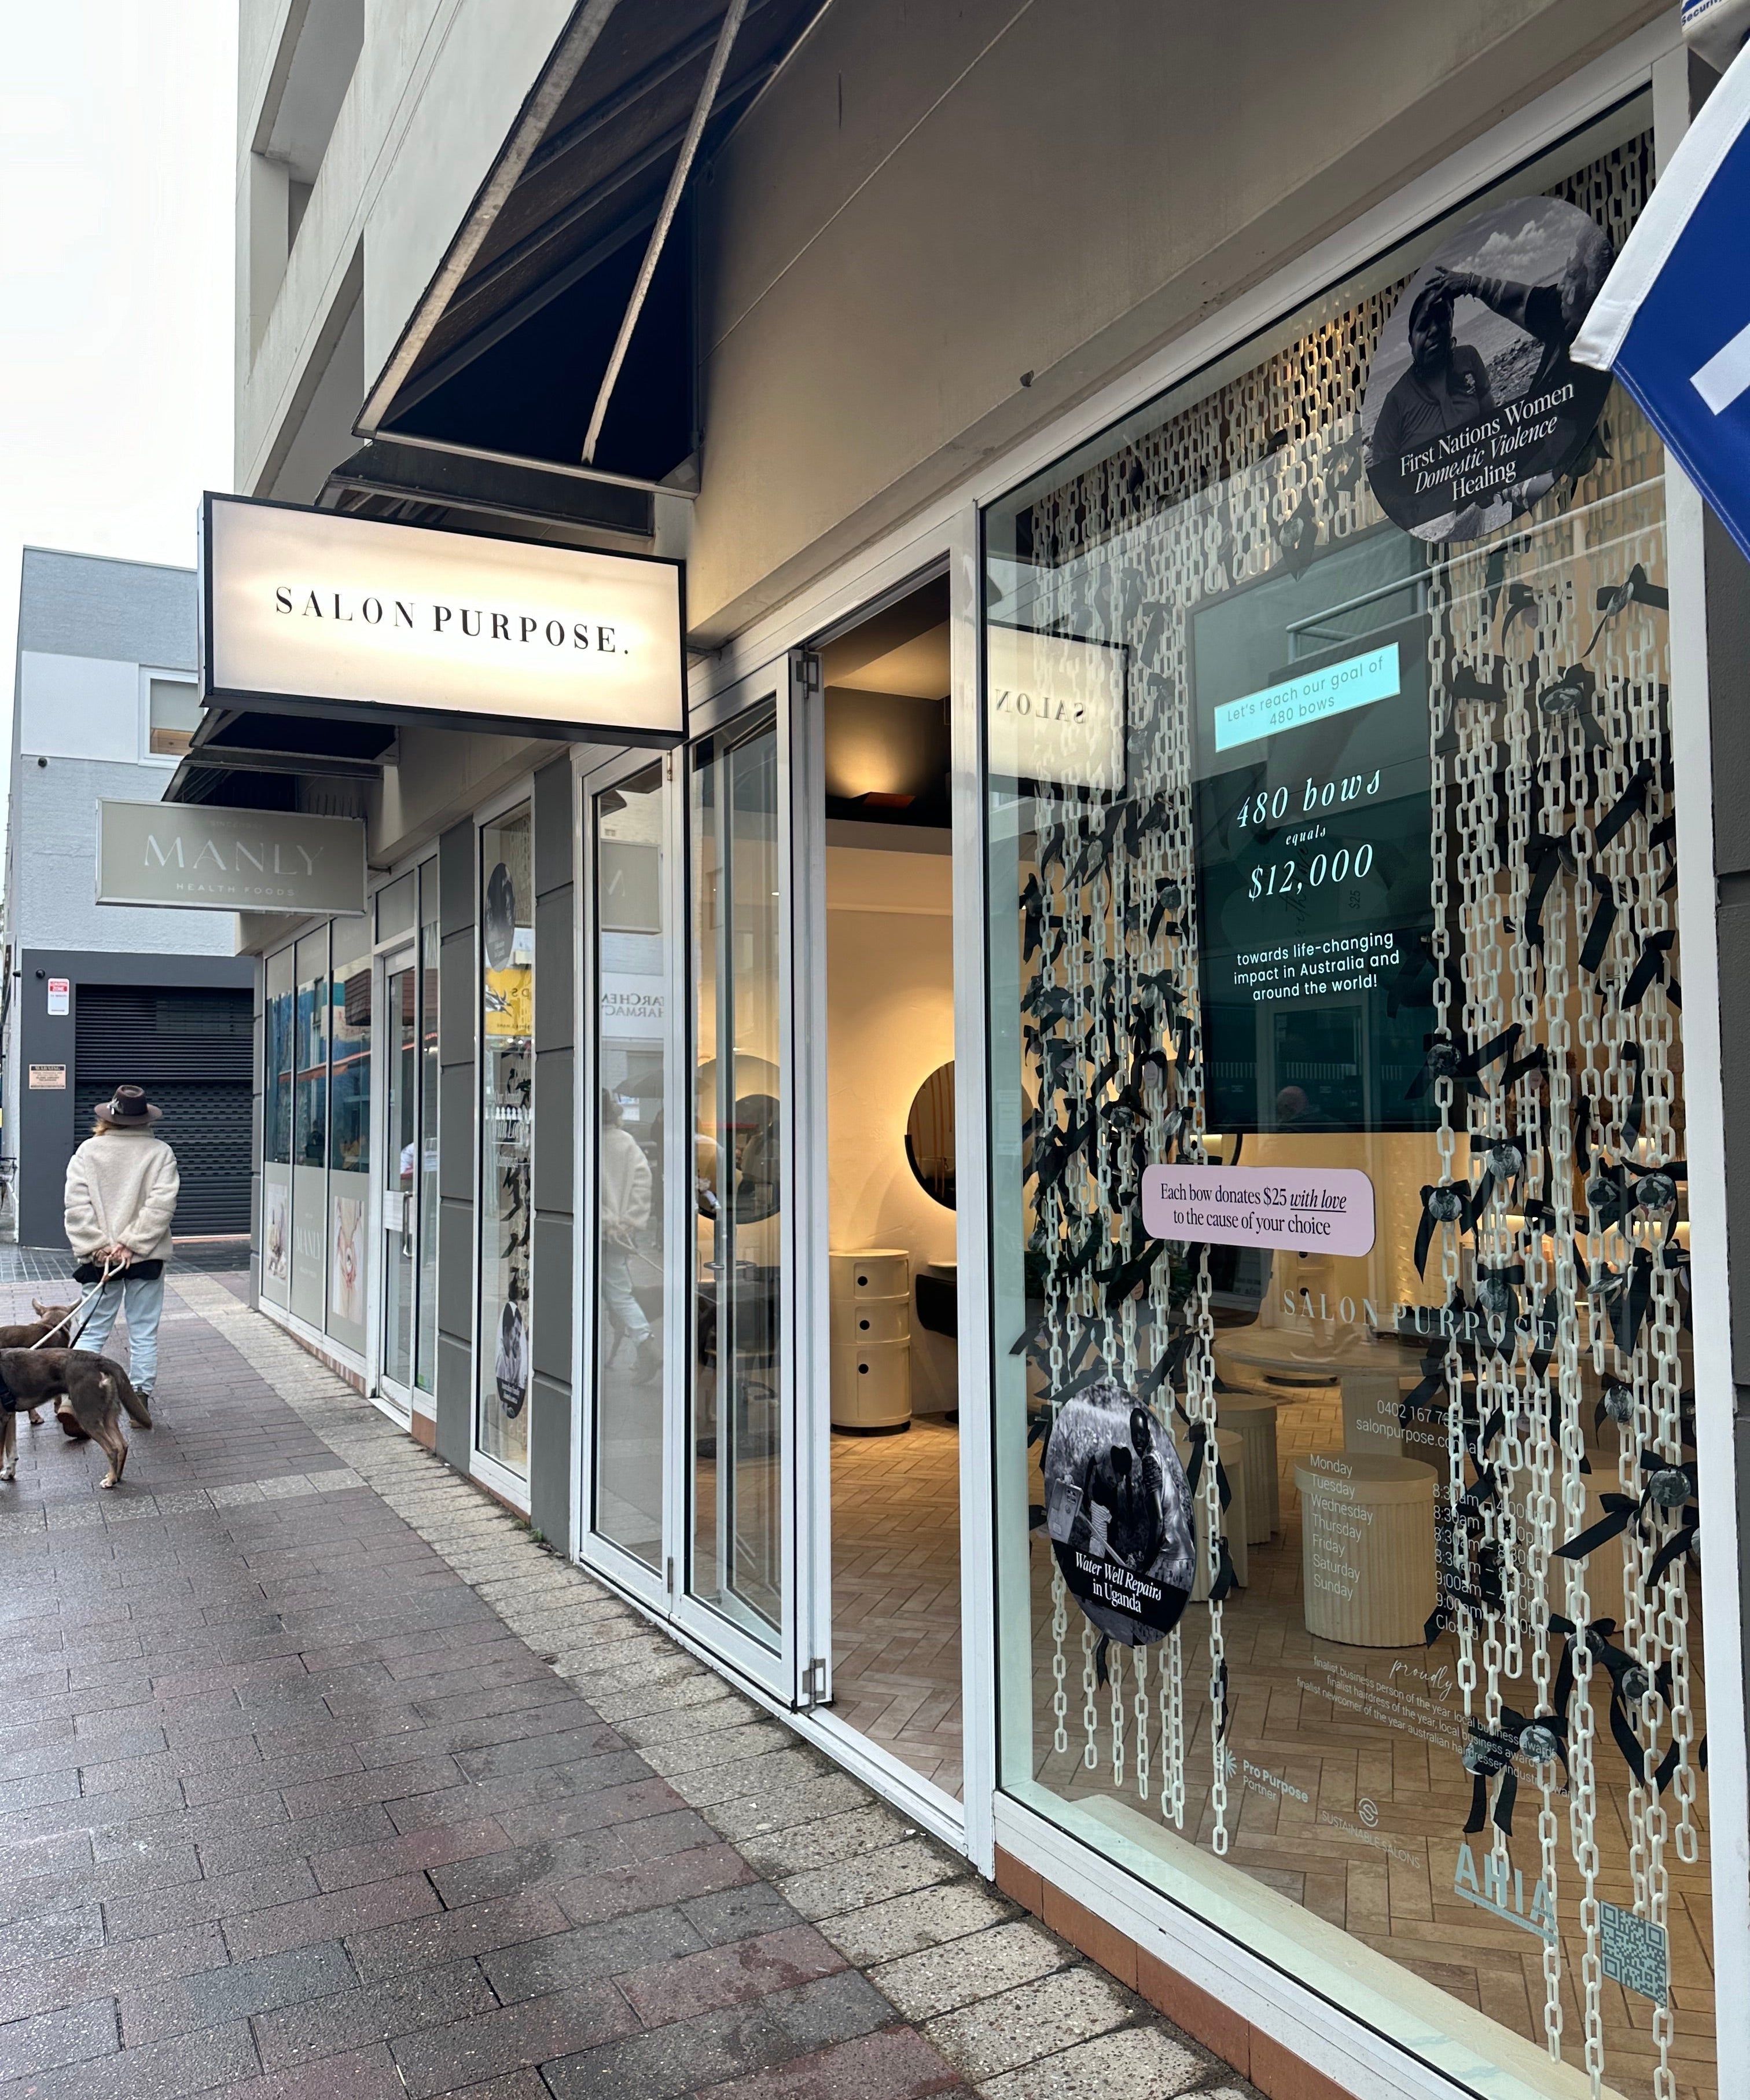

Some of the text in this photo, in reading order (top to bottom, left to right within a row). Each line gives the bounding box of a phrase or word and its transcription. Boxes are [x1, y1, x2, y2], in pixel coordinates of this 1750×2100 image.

[1681, 0, 1722, 26] Securi
[1400, 383, 1573, 477] First Nations Women
[1414, 417, 1557, 494] Domestic Violence
[1453, 461, 1517, 501] Healing
[276, 586, 629, 655] SALON PURPOSE.
[1227, 655, 1384, 722] Let's reach our goal of
[1270, 696, 1334, 726] 480 bows
[1237, 770, 1380, 828] 480 bows
[144, 834, 323, 876] MANLY
[1286, 825, 1326, 846] equals
[176, 883, 295, 897] HEALTH FOODS
[1249, 844, 1373, 902] $12,000
[1234, 950, 1399, 987] impact in Australia and
[1237, 932, 1394, 965] towards life-changing
[1253, 974, 1377, 1001] around the world!
[1161, 1183, 1347, 1210] Each bow donates $25 with love
[1174, 1209, 1330, 1235] to the cause of your choice
[1283, 1289, 1556, 1352] SALON PURPOSE
[1377, 1400, 1406, 1418] 0402
[1410, 1407, 1432, 1423] 167
[1310, 1453, 1352, 1479] Monday
[1311, 1474, 1355, 1499] Tuesday
[1433, 1505, 1480, 1529] 8:30am
[1311, 1493, 1373, 1525] Wednesday
[1311, 1513, 1362, 1542] Thursday
[1076, 1552, 1161, 1601] Water Well Repairs
[1312, 1534, 1345, 1558] Friday
[1435, 1571, 1481, 1597] 9:00am
[1313, 1554, 1361, 1583] Saturday
[1093, 1578, 1141, 1613] in Uganda
[1314, 1574, 1479, 1641] Sunday Cloed
[1314, 1656, 1338, 1674] finalist
[1340, 1666, 1374, 1688] business
[1376, 1682, 1404, 1699] person
[1406, 1694, 1415, 1704] of
[1417, 1696, 1430, 1709] the
[1432, 1704, 1451, 1717] year
[1454, 1710, 1475, 1727] local
[1389, 1660, 1453, 1701] proudly
[1297, 1676, 1321, 1695] finalist
[1322, 1690, 1362, 1710] newcomer
[1363, 1704, 1372, 1714] of
[1374, 1709, 1387, 1722] the
[1388, 1717, 1406, 1730] year
[1407, 1725, 1450, 1749] australian
[1452, 1741, 1502, 1770] hairdresser
[1505, 1761, 1542, 1787] industr
[1327, 1675, 1352, 1694] finalist
[1354, 1685, 1390, 1709] hairdress
[1392, 1702, 1400, 1713] of
[1402, 1706, 1416, 1719] the
[1417, 1713, 1437, 1730] year,
[1439, 1719, 1459, 1737] local
[1462, 1730, 1503, 1754] business
[1243, 1760, 1308, 1803] Pro Purpose
[1243, 1776, 1277, 1801] Partner
[1322, 1811, 1420, 1868] SUSTAINABLE SALONS
[1454, 1843, 1557, 1932] AHIA
